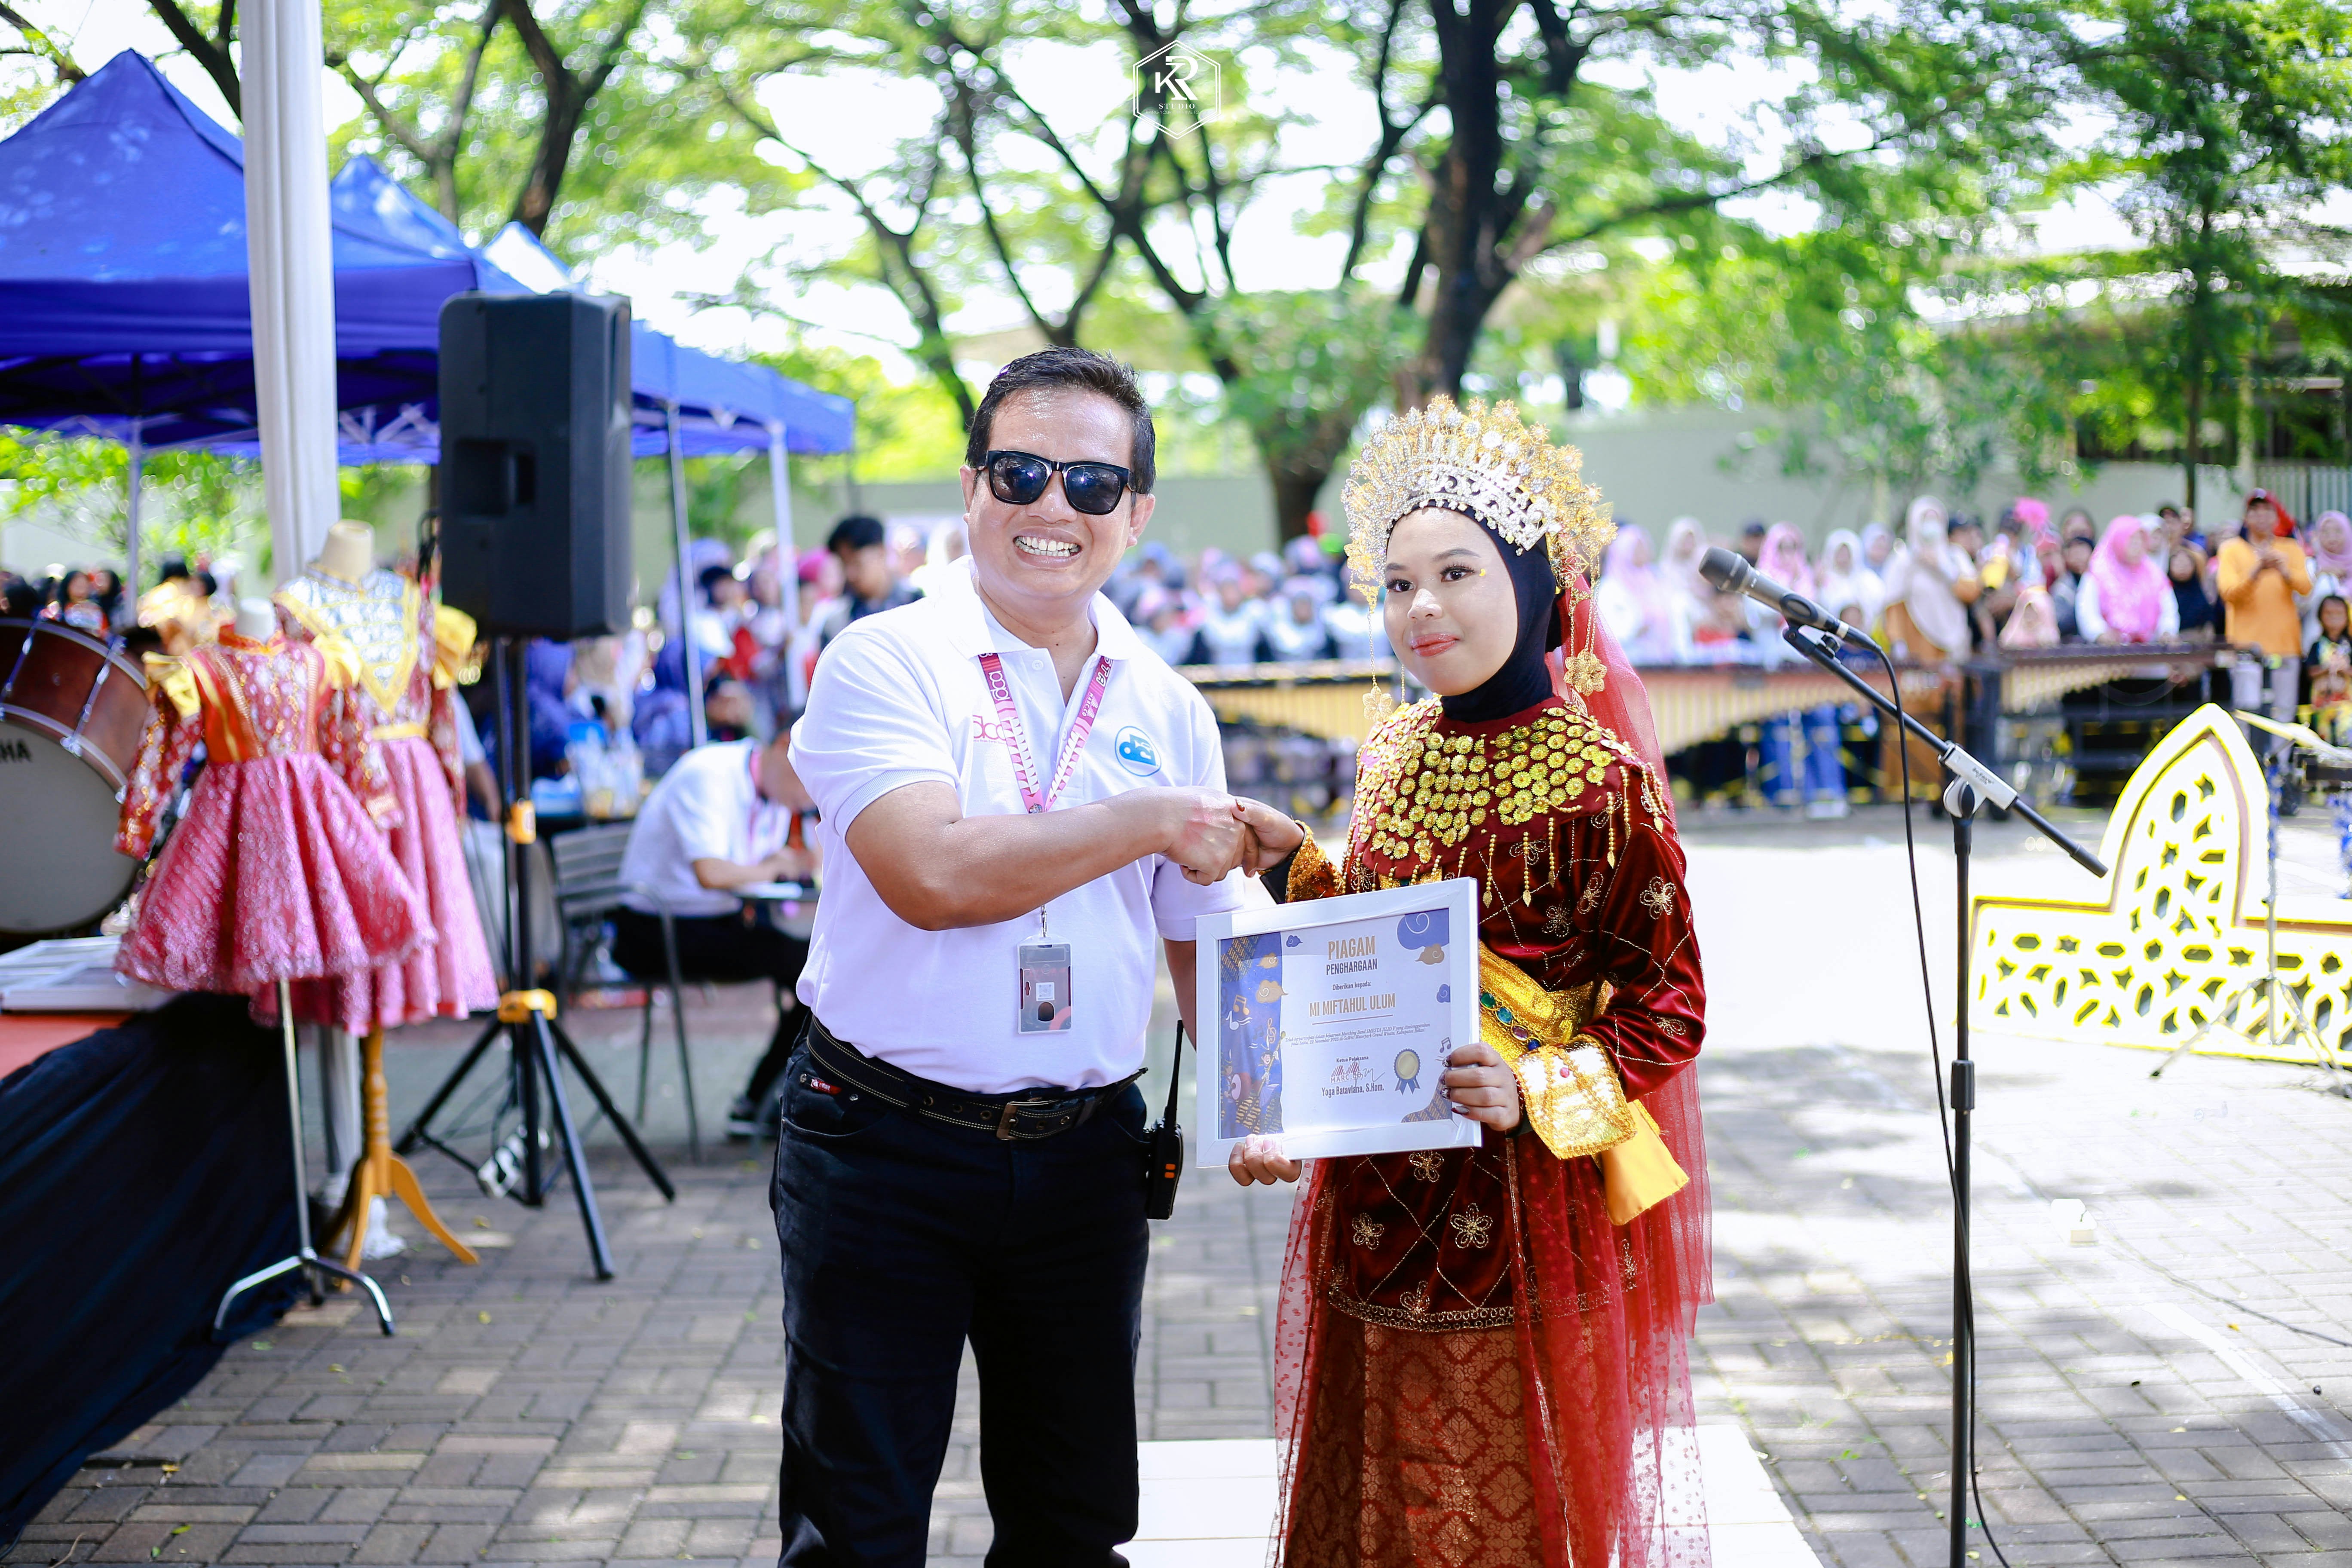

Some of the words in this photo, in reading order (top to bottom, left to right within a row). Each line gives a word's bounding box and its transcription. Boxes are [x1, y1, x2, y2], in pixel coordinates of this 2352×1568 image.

[1328, 935, 1375, 960] PIAGAM
[1326, 958, 1378, 975] PENGHARGAAN
[1354, 980, 1371, 989] kepada:
[1310, 1002, 1320, 1017] MI
[1323, 996, 1367, 1015] MIFTAHUL
[1369, 993, 1395, 1010] ULUM
[1322, 1087, 1335, 1098] Yoga
[1336, 1085, 1364, 1095] Bataviana,
[1366, 1082, 1384, 1092] S.Kom.
